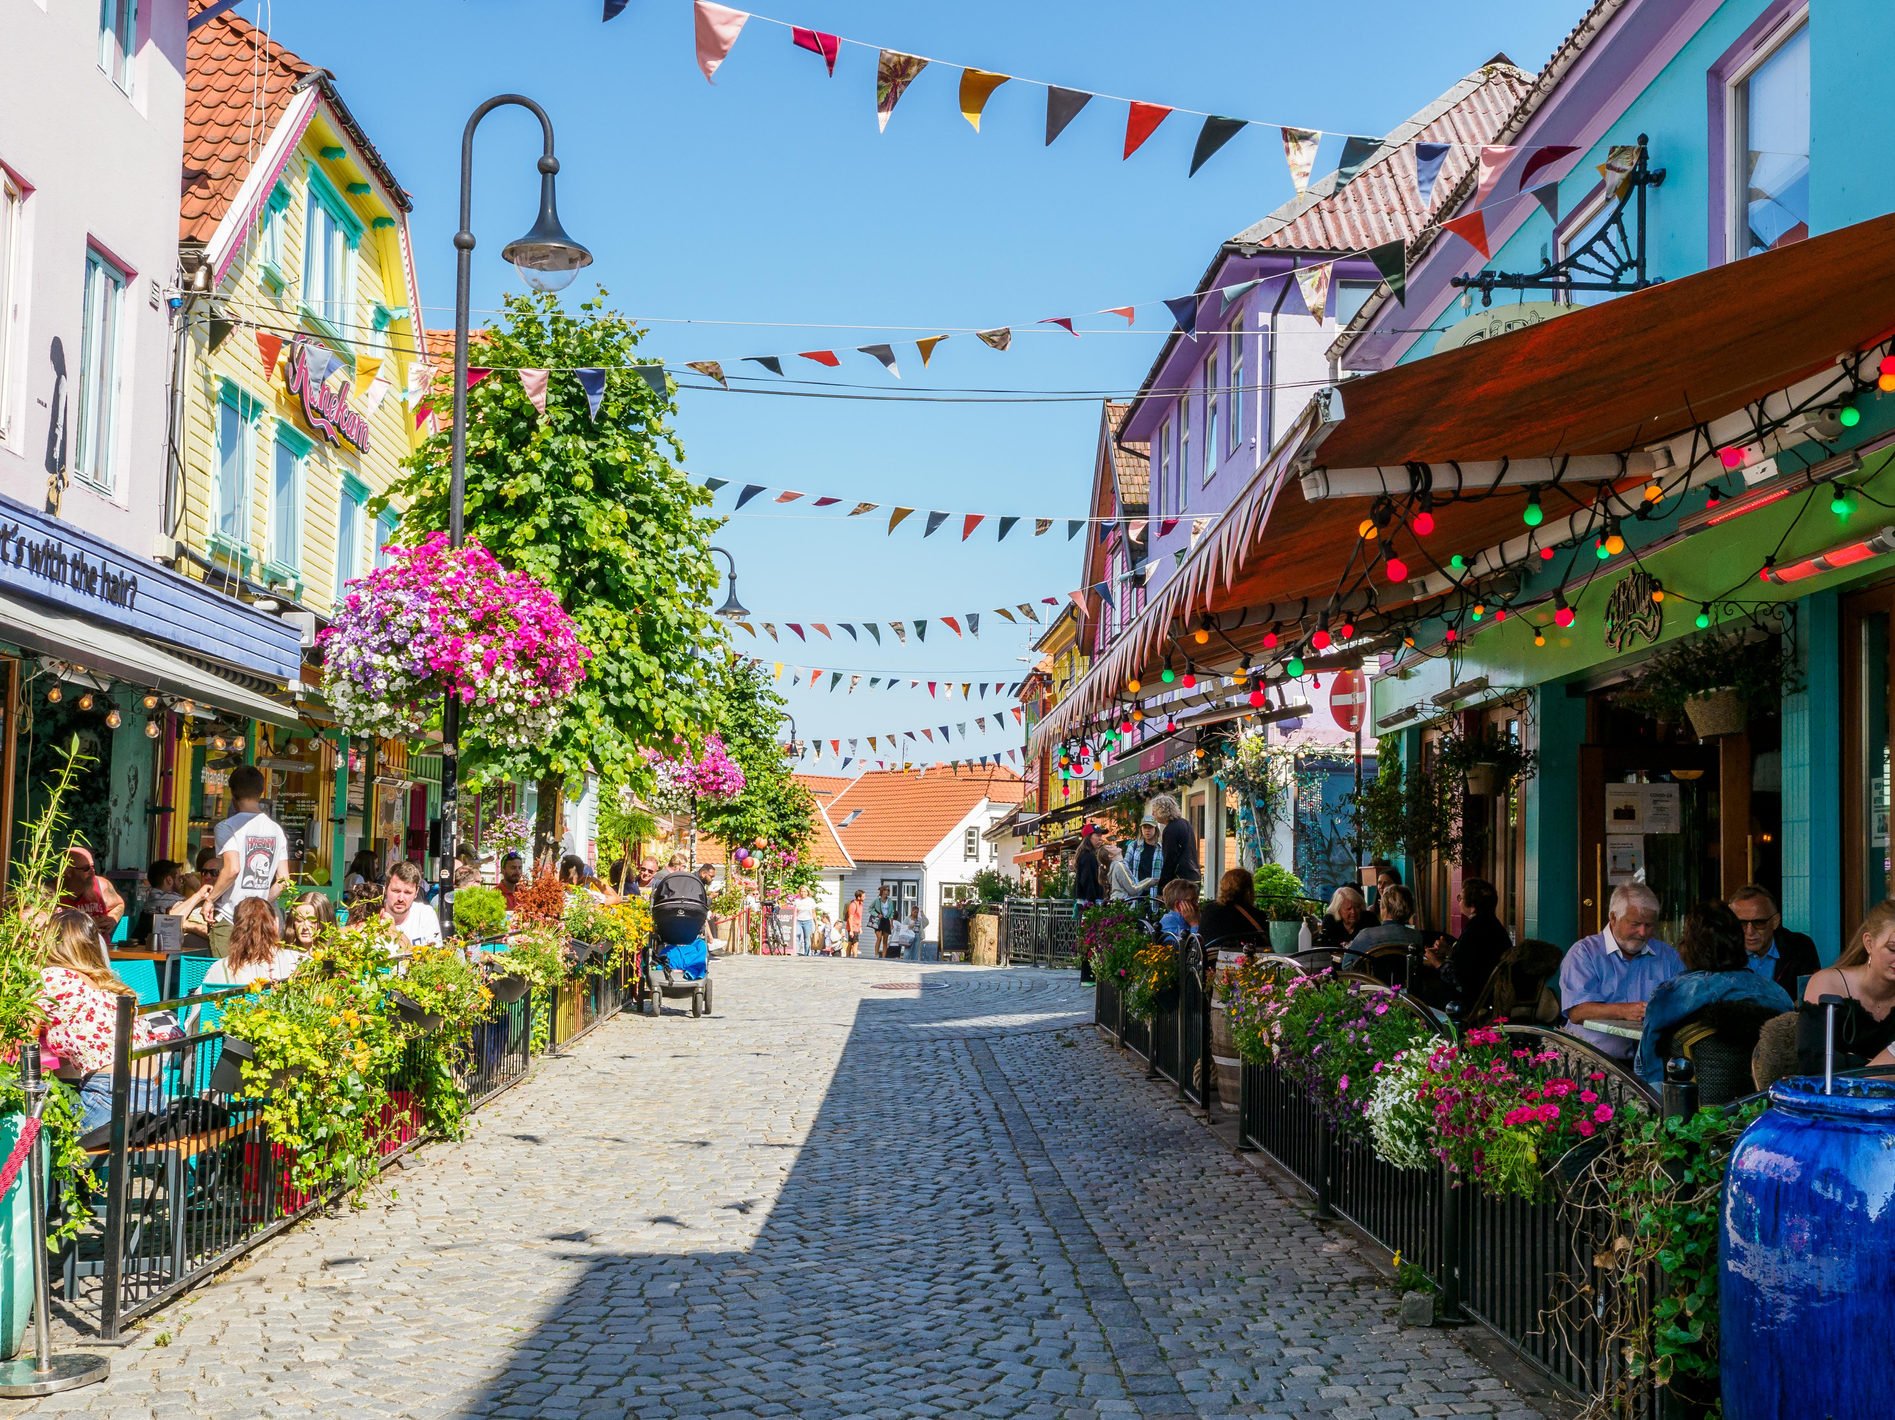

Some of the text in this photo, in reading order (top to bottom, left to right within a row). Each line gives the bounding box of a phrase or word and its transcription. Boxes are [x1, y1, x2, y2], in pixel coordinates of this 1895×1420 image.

[286, 333, 370, 454] Hnekam
[0, 523, 138, 612] t's with the hair?
[201, 766, 231, 787] #haneka
